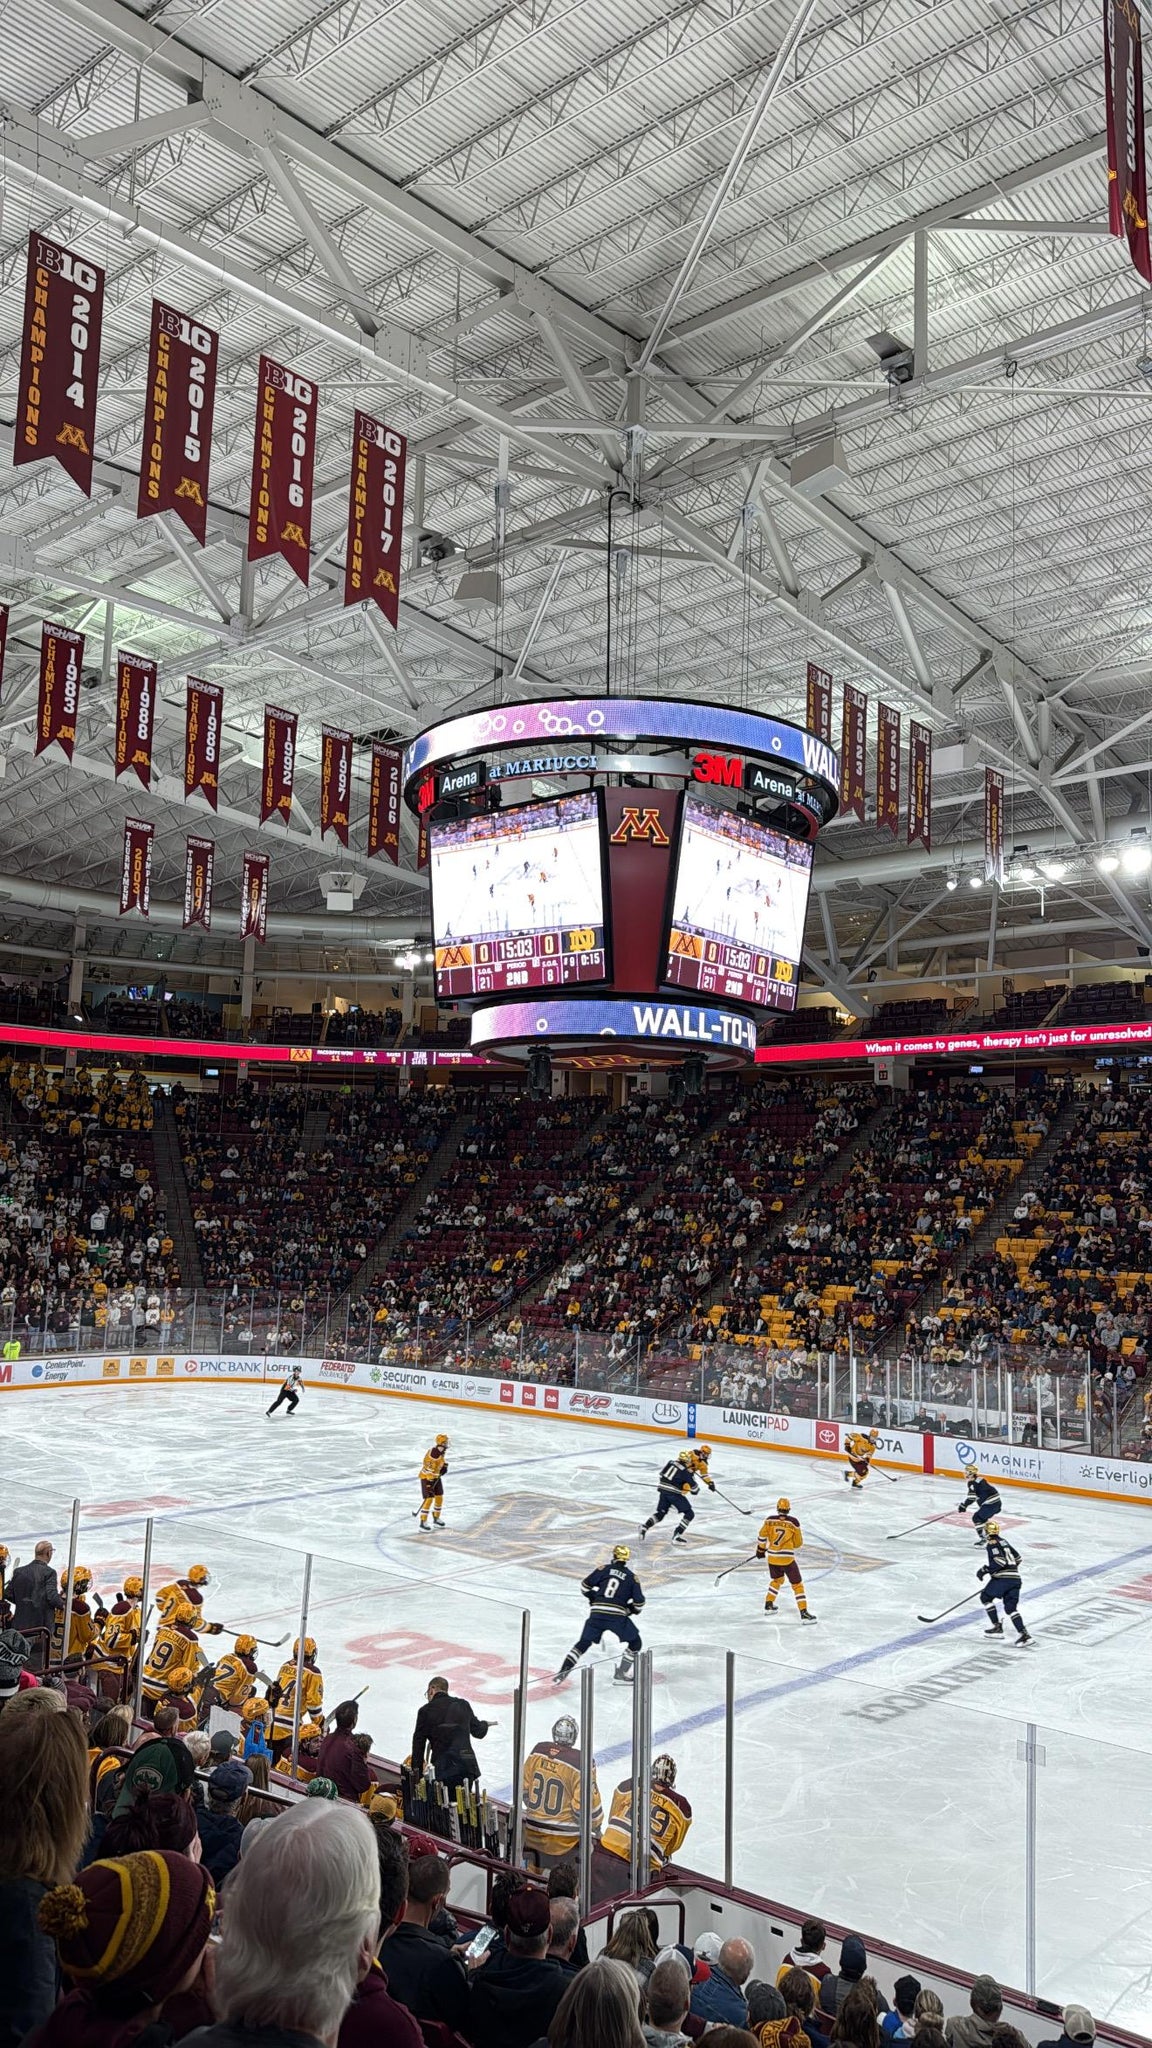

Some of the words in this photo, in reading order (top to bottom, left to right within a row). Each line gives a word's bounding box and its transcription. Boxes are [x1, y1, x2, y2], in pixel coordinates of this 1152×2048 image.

[25, 267, 49, 446] CHAMPIONS
[66, 294, 90, 409] 2014
[147, 333, 170, 499] CHAMPIONS
[184, 357, 207, 463] 2015
[256, 386, 276, 543] CHAMPIONS
[288, 408, 307, 507] 2016
[351, 439, 368, 589] CHAMPIONS
[380, 459, 398, 554] 2017
[42, 638, 57, 738] CHAMPIONS
[63, 648, 78, 714] 1983
[117, 666, 131, 764] CHAMPIONS
[137, 676, 150, 740] 1988
[820, 694, 828, 742] 202
[187, 692, 199, 785] CHAMPIONS
[205, 701, 217, 762] 1989
[856, 713, 864, 776] 2023
[266, 719, 277, 807] CHAMPIONS
[283, 727, 293, 786] 1992
[889, 730, 897, 792] 2025
[322, 738, 333, 824] CHAMPIONS
[338, 745, 347, 802] 1997
[489, 767, 501, 778] at
[693, 752, 743, 788] 3M
[754, 771, 793, 798] Arena
[370, 757, 381, 847] CHAMPIONS
[388, 767, 399, 824] 2006
[418, 776, 435, 814] 3M
[441, 771, 477, 794] Arena
[121, 832, 132, 909] TOURNAMENT
[143, 837, 153, 911] CHAMPIONS
[184, 849, 194, 924] TOURNAMENT
[204, 854, 213, 925] CHAMPIONS
[480, 943, 489, 963] 0
[500, 938, 533, 960] 15:03
[545, 935, 554, 955] 0
[708, 943, 717, 962] 0
[581, 953, 600, 965] 0:15
[725, 948, 751, 970] 15:03
[757, 956, 766, 975] 0
[479, 976, 491, 989] 21
[506, 972, 528, 987] 2ND
[865, 1043, 893, 1054] When
[894, 1042, 902, 1053] it
[903, 1042, 933, 1052] comes
[935, 1040, 945, 1050] to
[948, 1039, 980, 1052] genes,
[983, 1036, 1022, 1048] therapy
[1024, 1034, 1047, 1045] isn't
[1048, 1033, 1069, 1045] just
[1070, 1030, 1087, 1042] for
[1089, 1027, 1152, 1041] unresolved
[45, 1359, 84, 1370] CenterPoint
[200, 1361, 227, 1372] PNC
[228, 1362, 262, 1373] BANK
[321, 1361, 356, 1374] FEDERATED
[44, 1371, 69, 1382] Energy
[382, 1382, 413, 1392] FINANCIAL
[383, 1371, 427, 1386] securian
[502, 1388, 512, 1397] Cub
[524, 1391, 534, 1400] Cub
[546, 1394, 557, 1403] Cub
[569, 1392, 612, 1410] FVP
[616, 1408, 638, 1417] PRODUCTS
[655, 1402, 679, 1418] CHS
[722, 1410, 790, 1431] LAUNCHPAD
[747, 1429, 764, 1439] GOLF
[874, 1437, 904, 1455] OTA
[980, 1452, 1041, 1471] MAGNIFI
[663, 1465, 678, 1481] 11
[1002, 1468, 1041, 1480] FINANCIAL
[773, 1528, 786, 1546] 7
[604, 1577, 620, 1599] 8
[108, 1624, 121, 1635] 33
[522, 1771, 565, 1817] 30
[650, 1792, 668, 1807] REY
